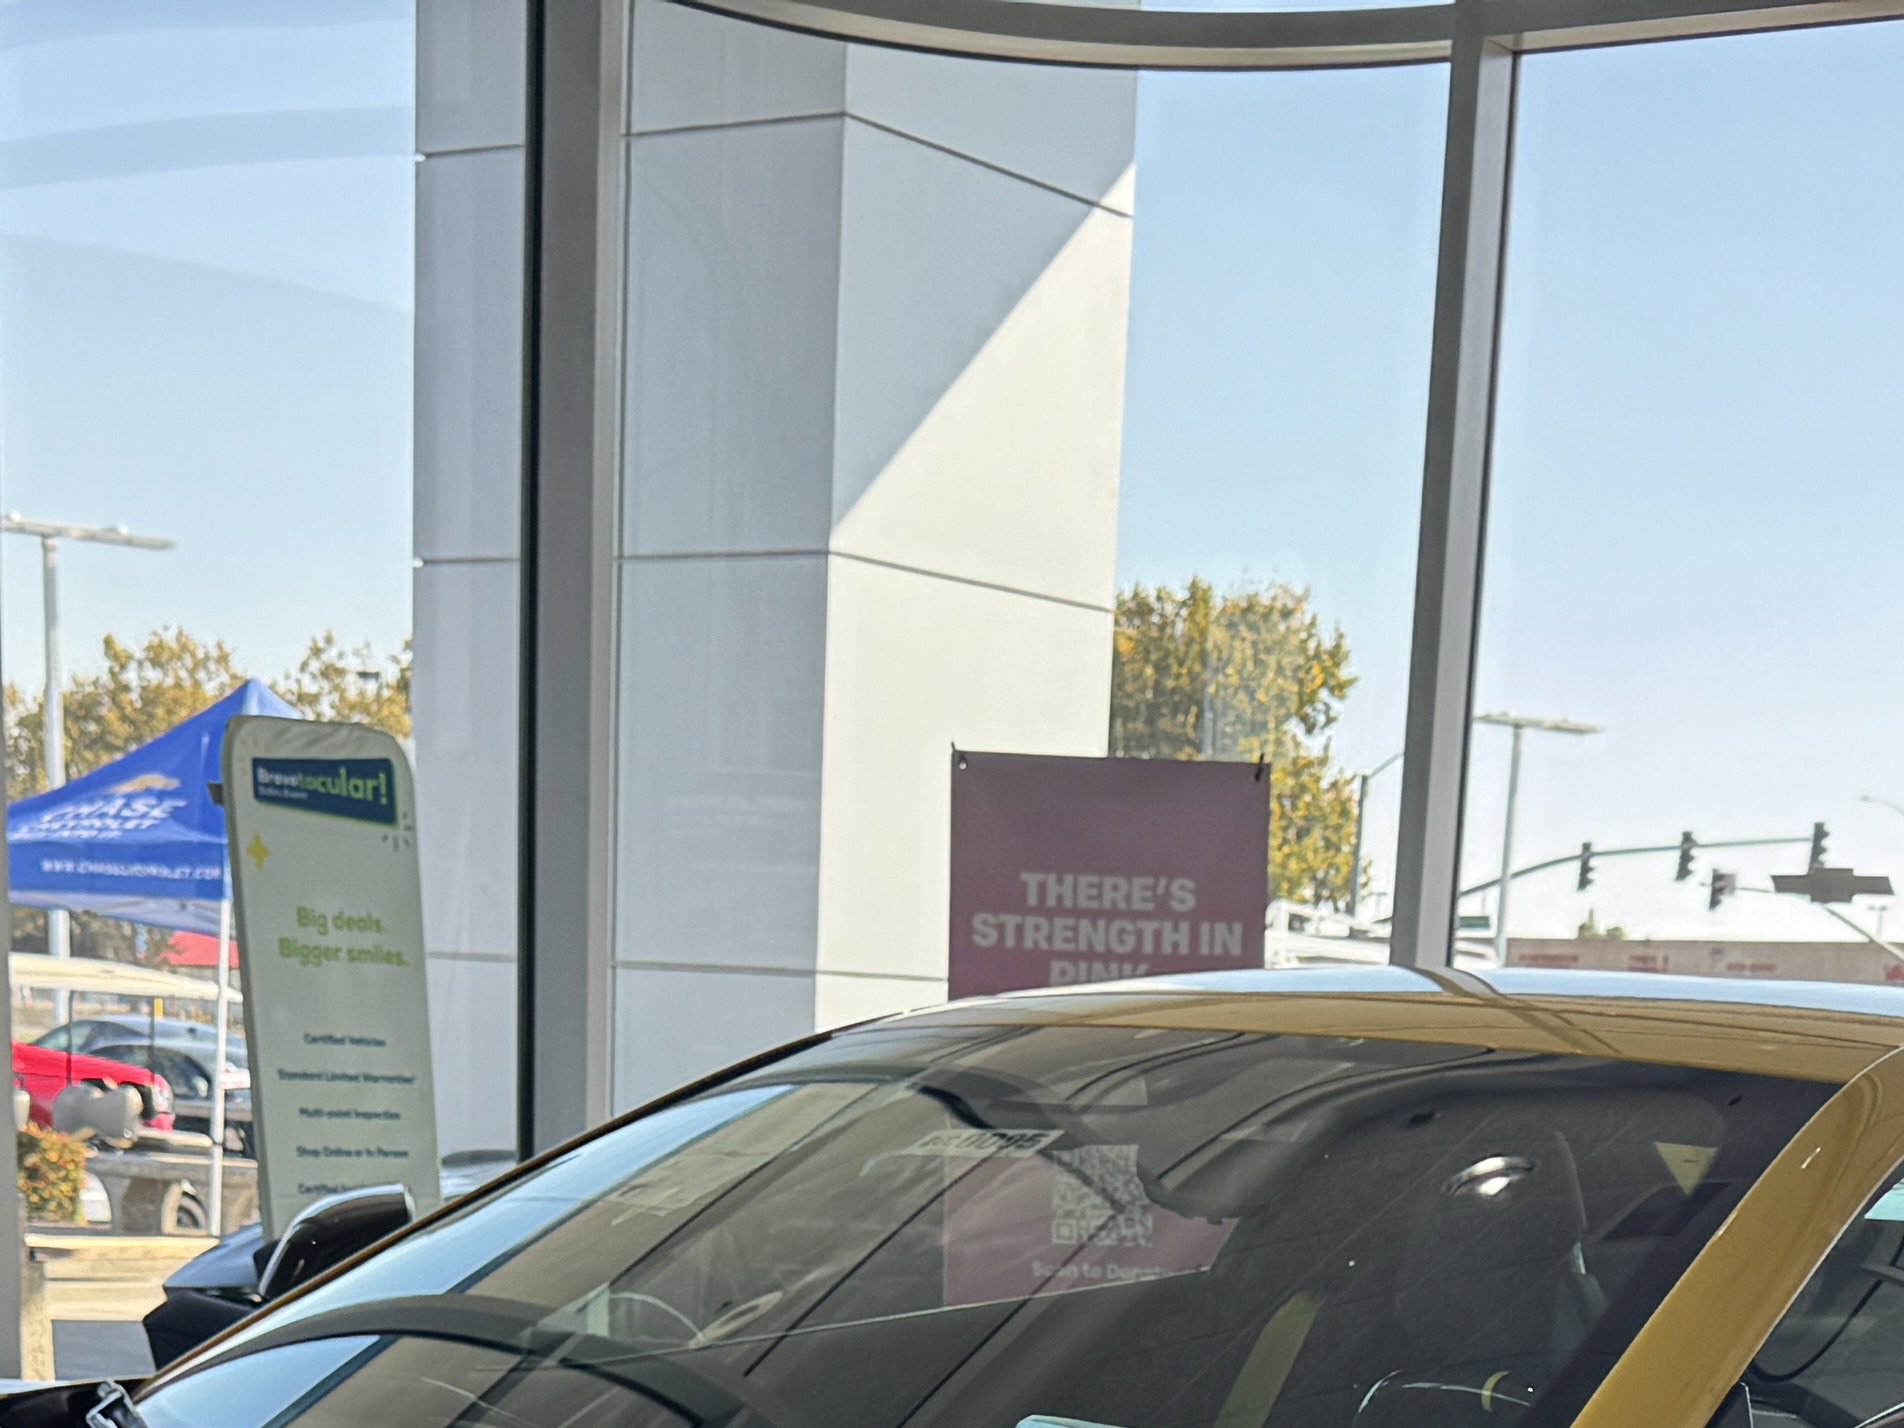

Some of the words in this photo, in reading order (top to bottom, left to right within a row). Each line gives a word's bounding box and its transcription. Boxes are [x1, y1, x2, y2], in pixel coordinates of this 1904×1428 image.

[1020, 872, 1195, 913] THERE'S
[297, 906, 328, 936] Big
[332, 910, 388, 934] deals.
[971, 912, 1189, 955] STRENGTH
[1200, 921, 1242, 956] IN
[278, 936, 341, 968] Bigger
